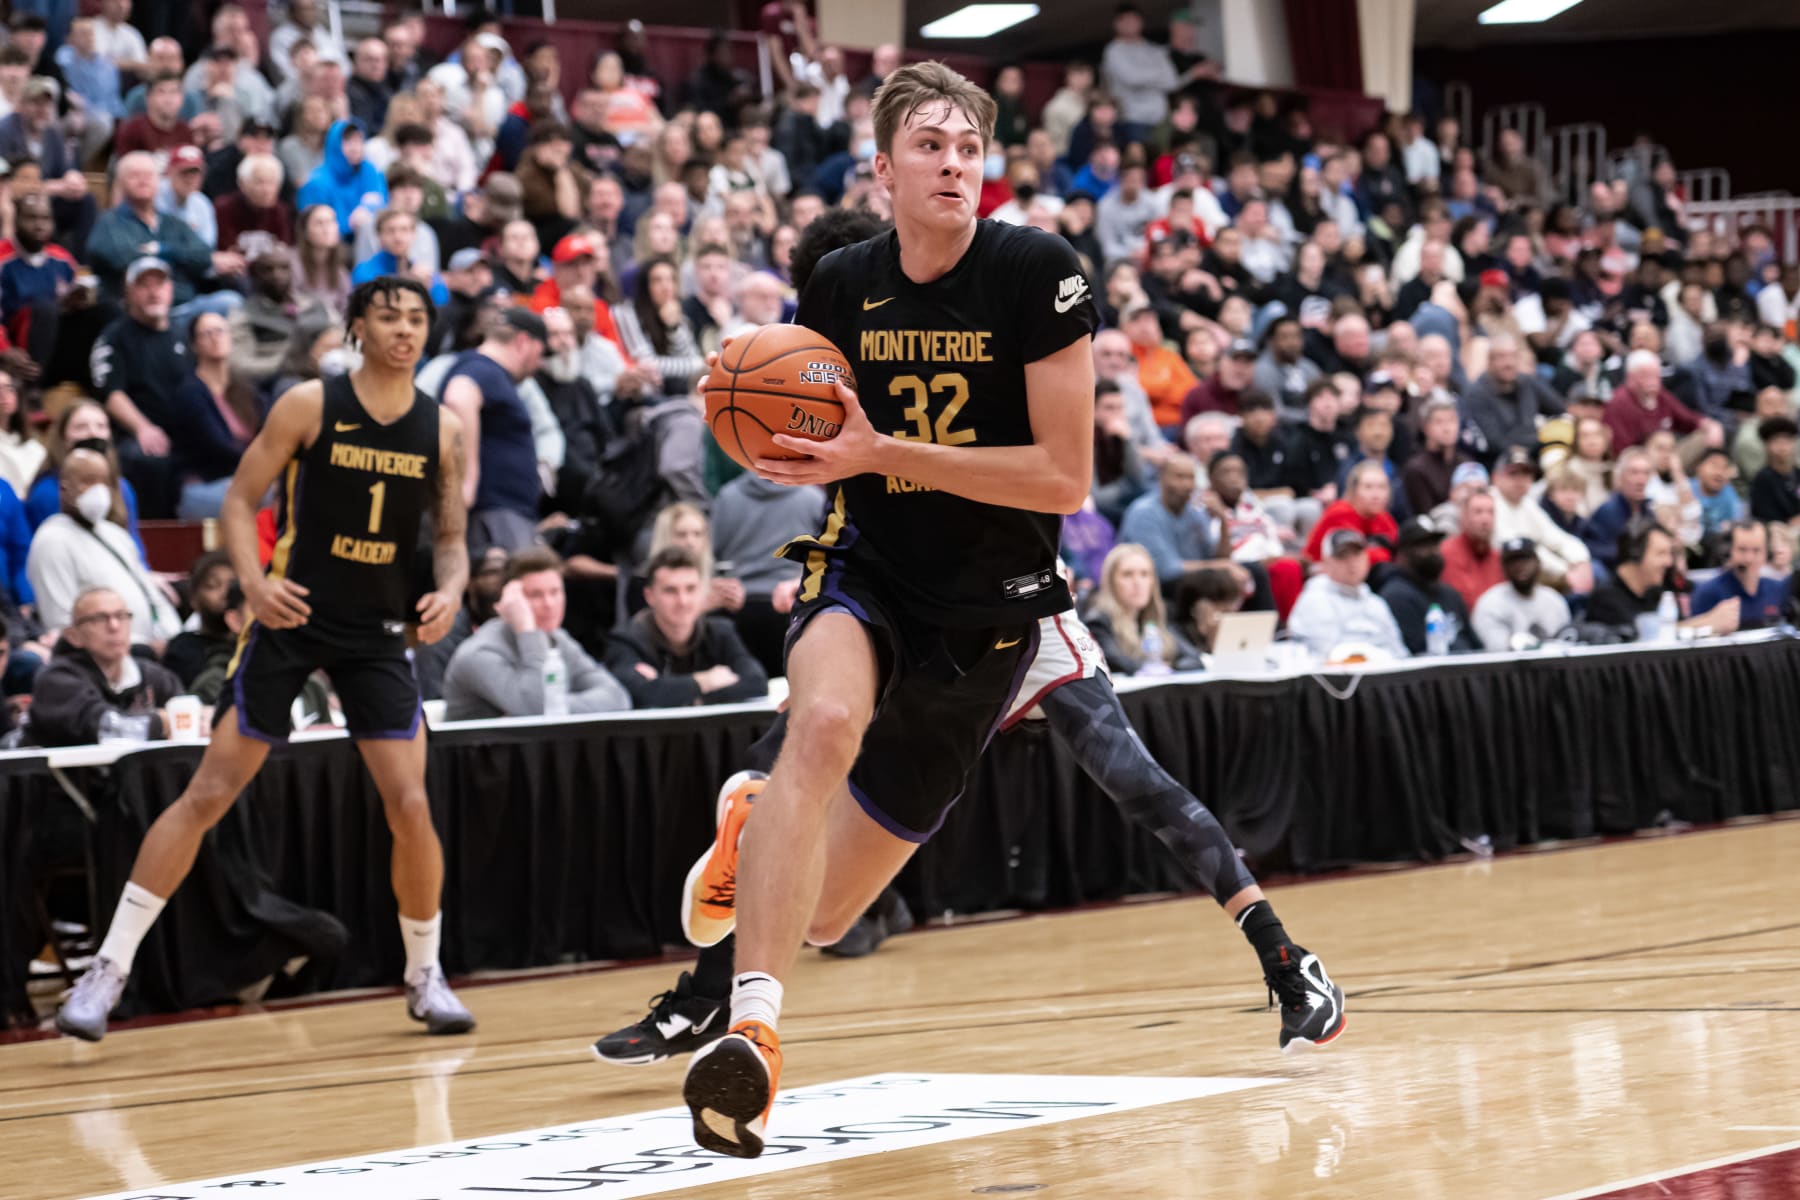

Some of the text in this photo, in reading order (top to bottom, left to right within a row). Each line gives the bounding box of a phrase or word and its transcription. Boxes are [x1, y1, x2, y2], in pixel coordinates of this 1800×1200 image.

[1058, 274, 1086, 299] NIKE
[860, 330, 993, 362] MONTVERDE
[888, 372, 977, 446] 32
[329, 442, 429, 480] MONTVERDE
[368, 480, 386, 535] 1
[330, 533, 398, 565] ACADEMY
[303, 1126, 634, 1176] SPORTS
